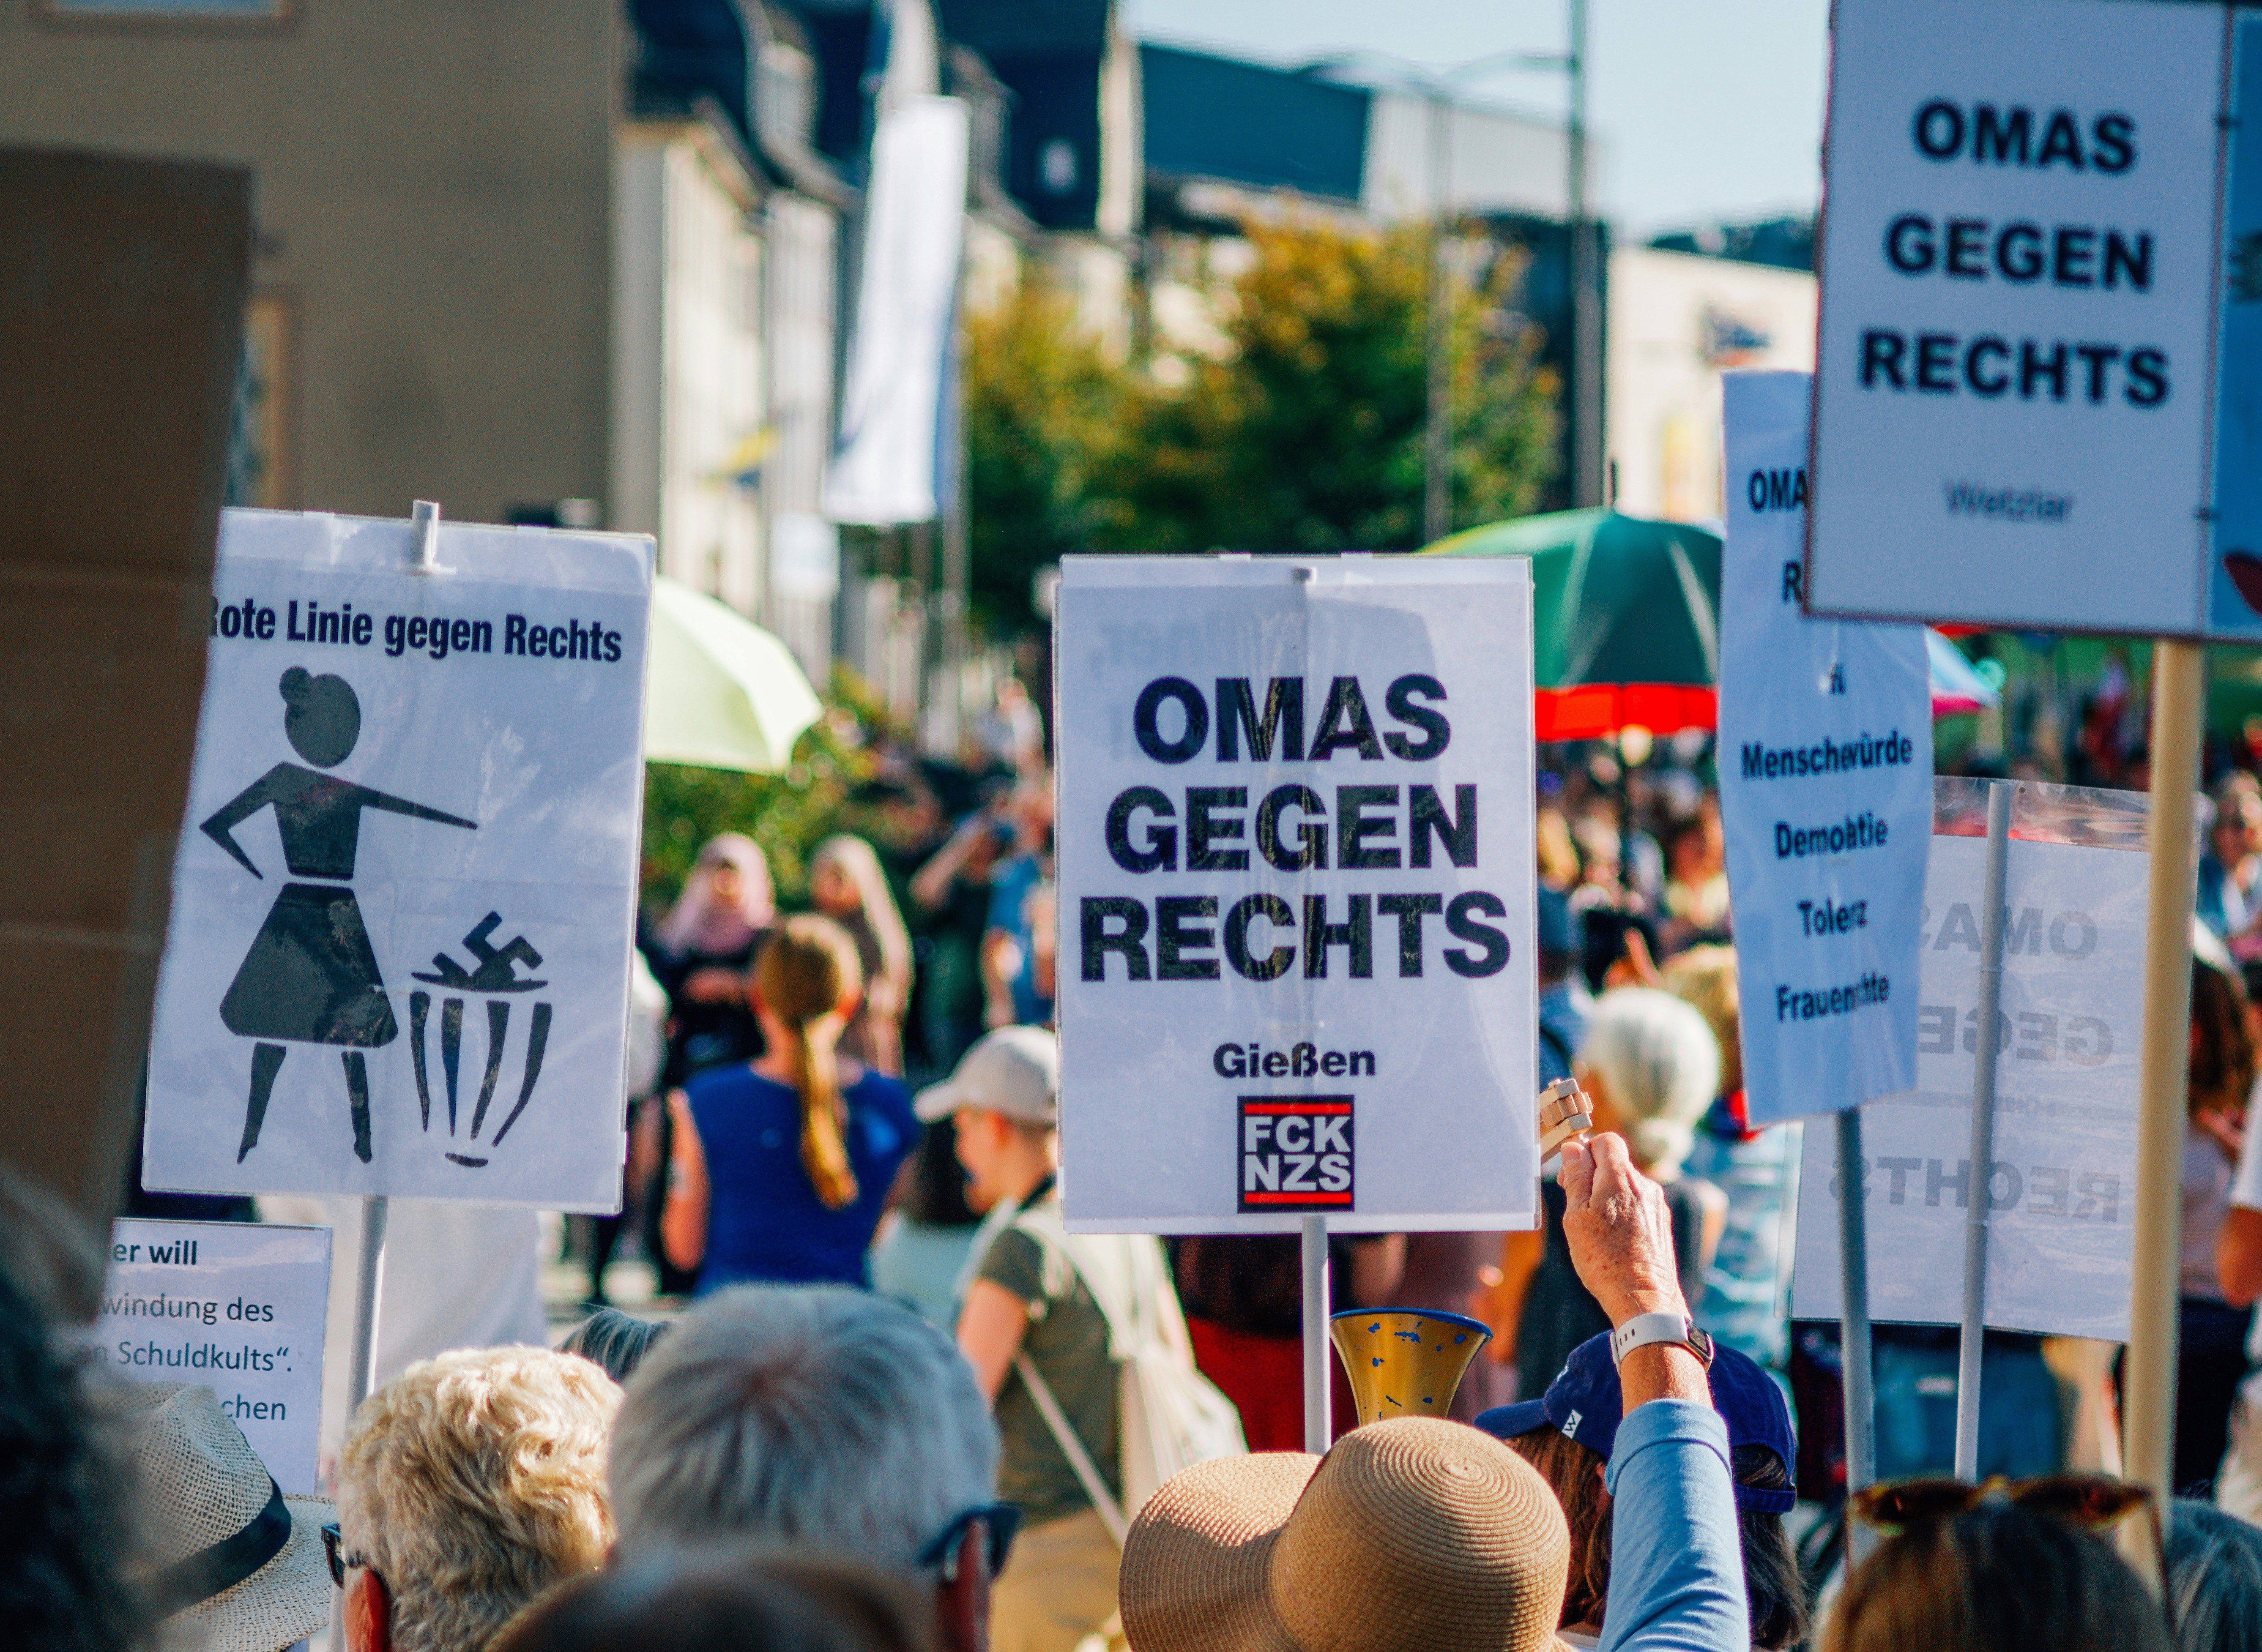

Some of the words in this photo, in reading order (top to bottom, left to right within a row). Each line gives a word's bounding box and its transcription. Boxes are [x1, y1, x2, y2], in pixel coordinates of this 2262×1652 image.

[1911, 97, 2136, 174] OMAS
[1885, 211, 2153, 292] GEGEN
[1861, 329, 2169, 408] RECHTS
[1945, 480, 2072, 522] Wetzlar
[287, 599, 372, 645] Linie
[385, 613, 492, 659] gegen
[504, 614, 622, 663] Rechts
[1133, 674, 1451, 765] OMAS
[1105, 784, 1478, 874] GEGEN
[1080, 891, 1511, 981] RECHTS
[1213, 1042, 1376, 1079] Gießen
[1245, 1115, 1351, 1152] FCK
[1245, 1153, 1352, 1191] NZS
[149, 1240, 197, 1265] will
[227, 1297, 274, 1322] des
